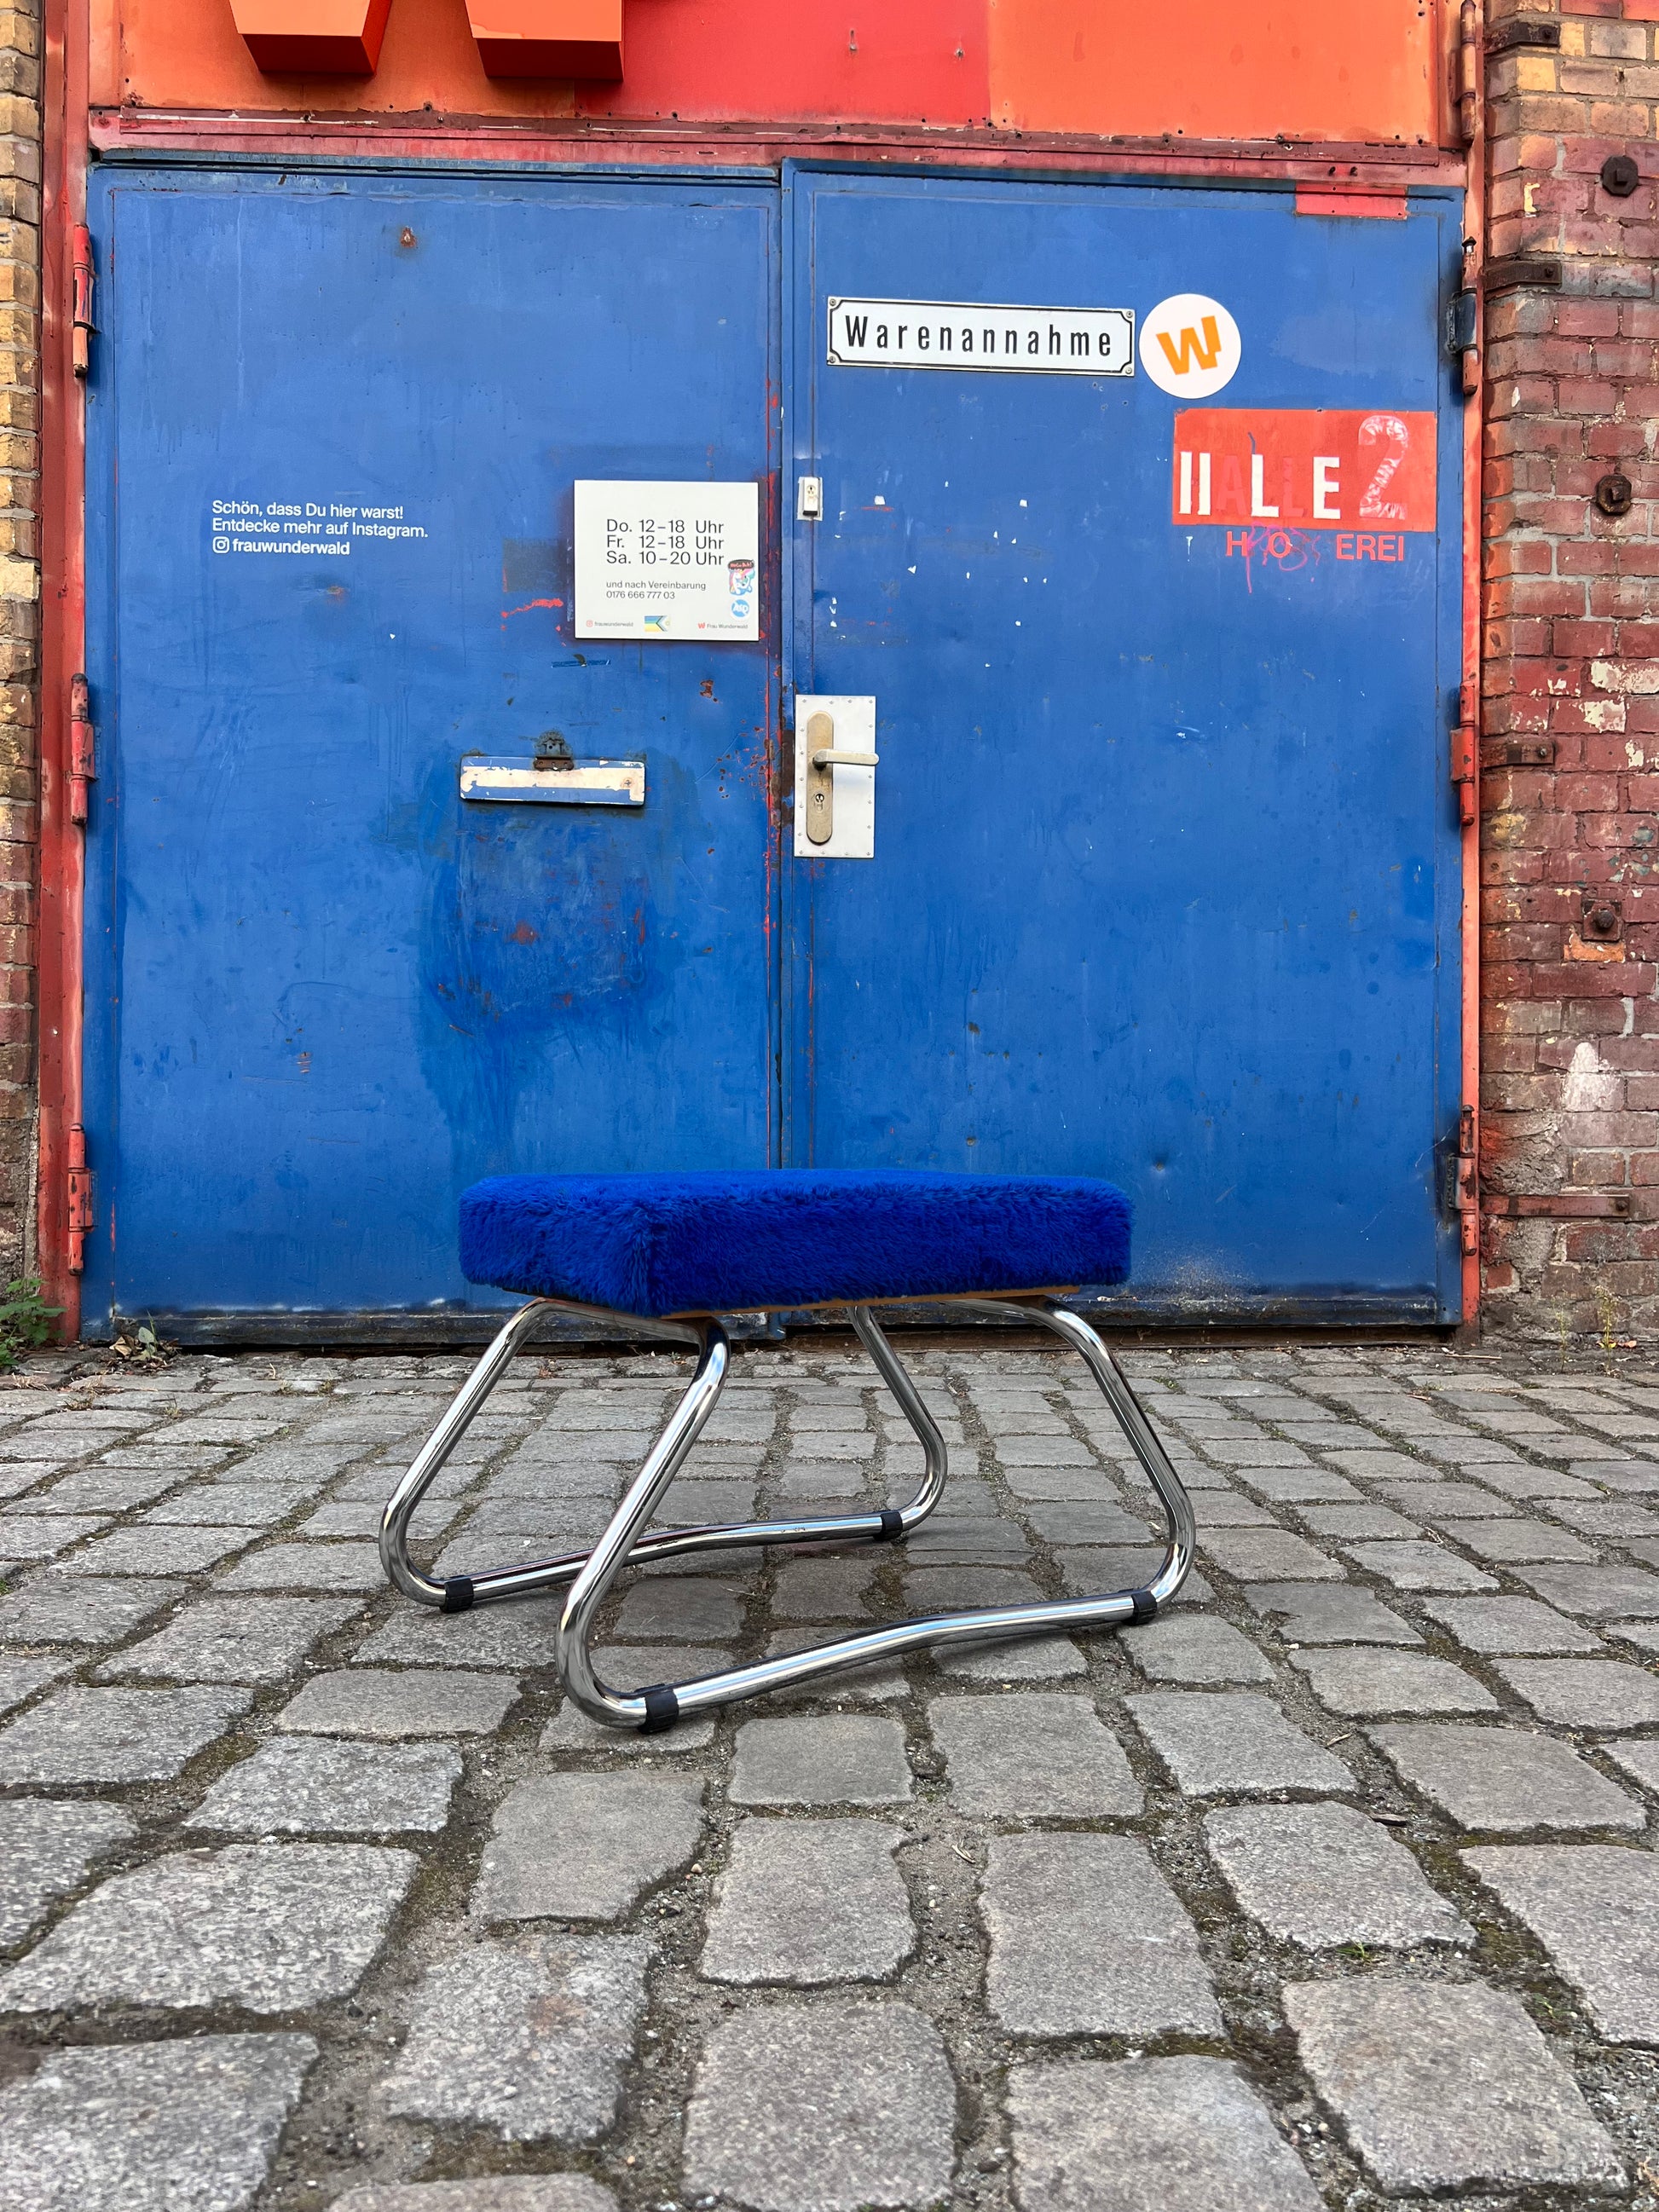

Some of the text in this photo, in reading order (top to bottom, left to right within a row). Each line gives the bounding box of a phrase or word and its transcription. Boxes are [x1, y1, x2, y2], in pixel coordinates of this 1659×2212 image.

[845, 315, 1112, 357] Warenannahme
[1358, 415, 1408, 520] 2
[212, 500, 404, 519] Schön, dass Du hier warst!
[212, 518, 429, 540] Entdecke mehr auf Instagram.
[606, 519, 633, 533] Do.
[696, 520, 725, 534] Uhr
[232, 539, 350, 555] frauwunderwald
[606, 534, 625, 548] Fr.
[696, 535, 725, 550] Uhr
[606, 551, 632, 564] Sa.
[696, 552, 725, 566] Uhr
[606, 580, 706, 591] und nach Vereinbarung
[627, 591, 645, 599] 666
[646, 591, 662, 599] 777
[663, 591, 675, 599] 03
